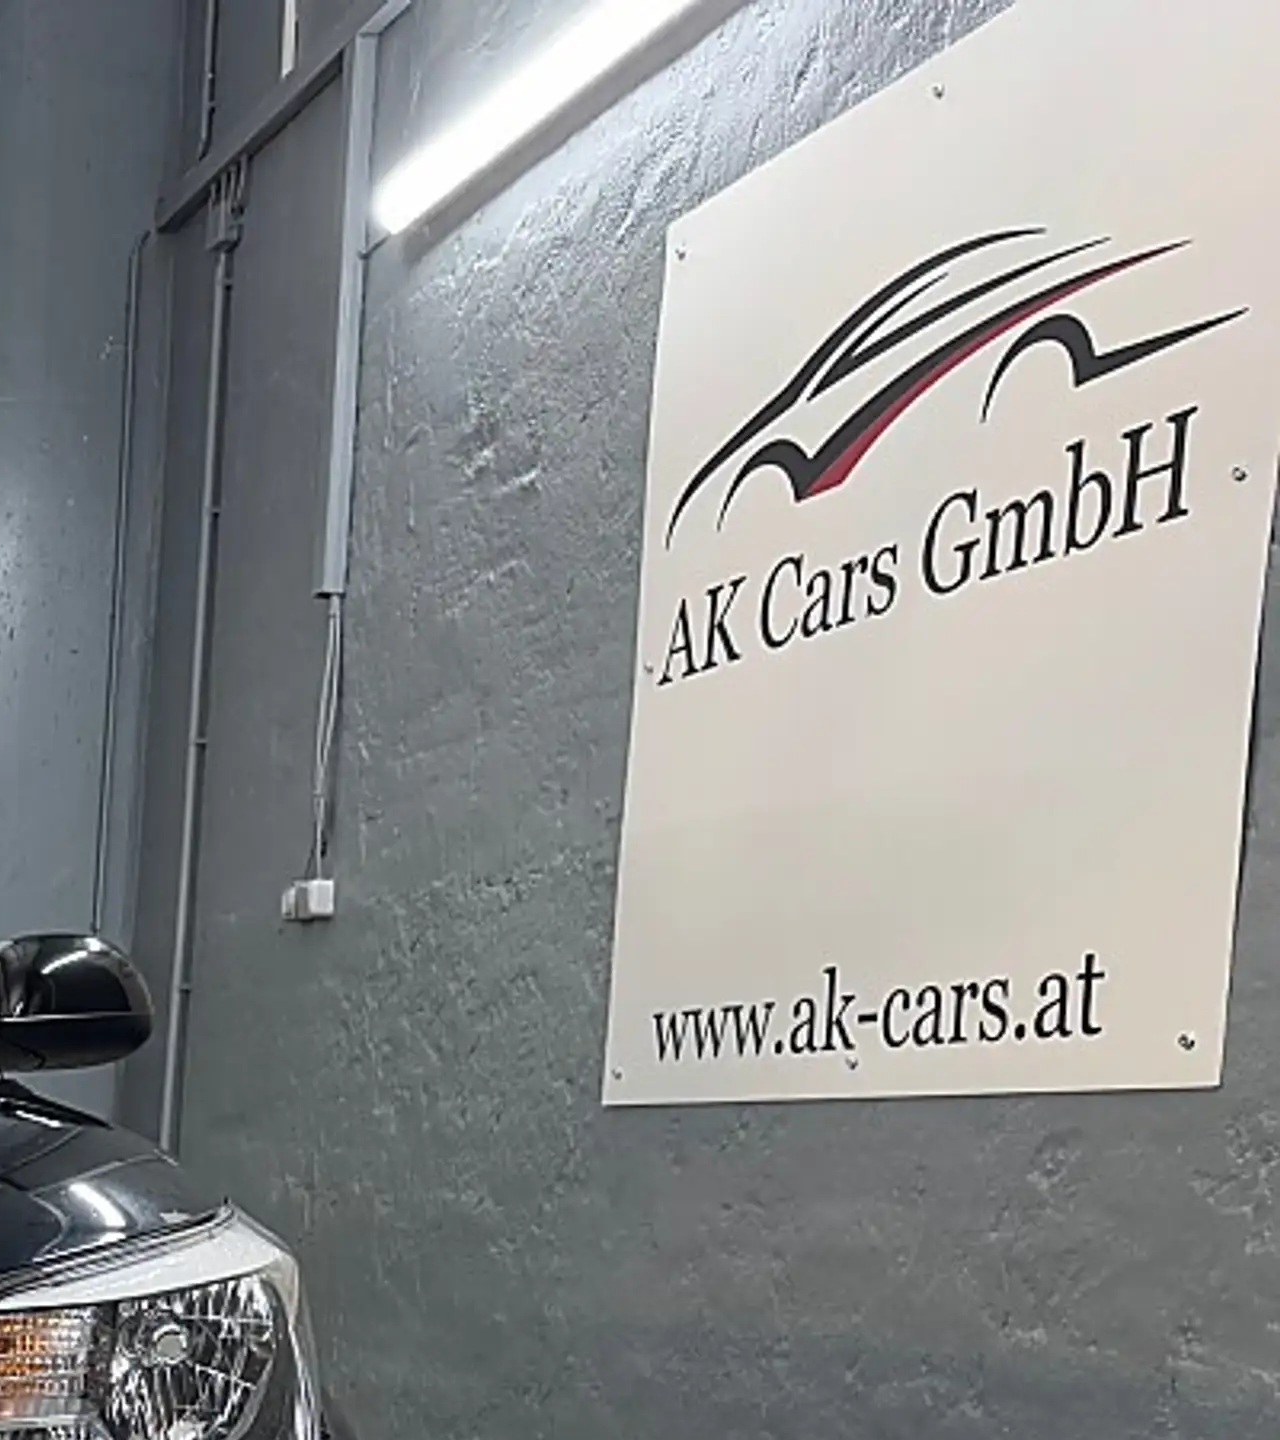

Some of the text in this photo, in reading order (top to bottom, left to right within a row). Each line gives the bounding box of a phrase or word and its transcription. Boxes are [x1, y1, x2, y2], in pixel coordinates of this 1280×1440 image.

[657, 406, 1198, 686] AK Cars GmbH
[651, 952, 1106, 1062] www.ak-cars.at
